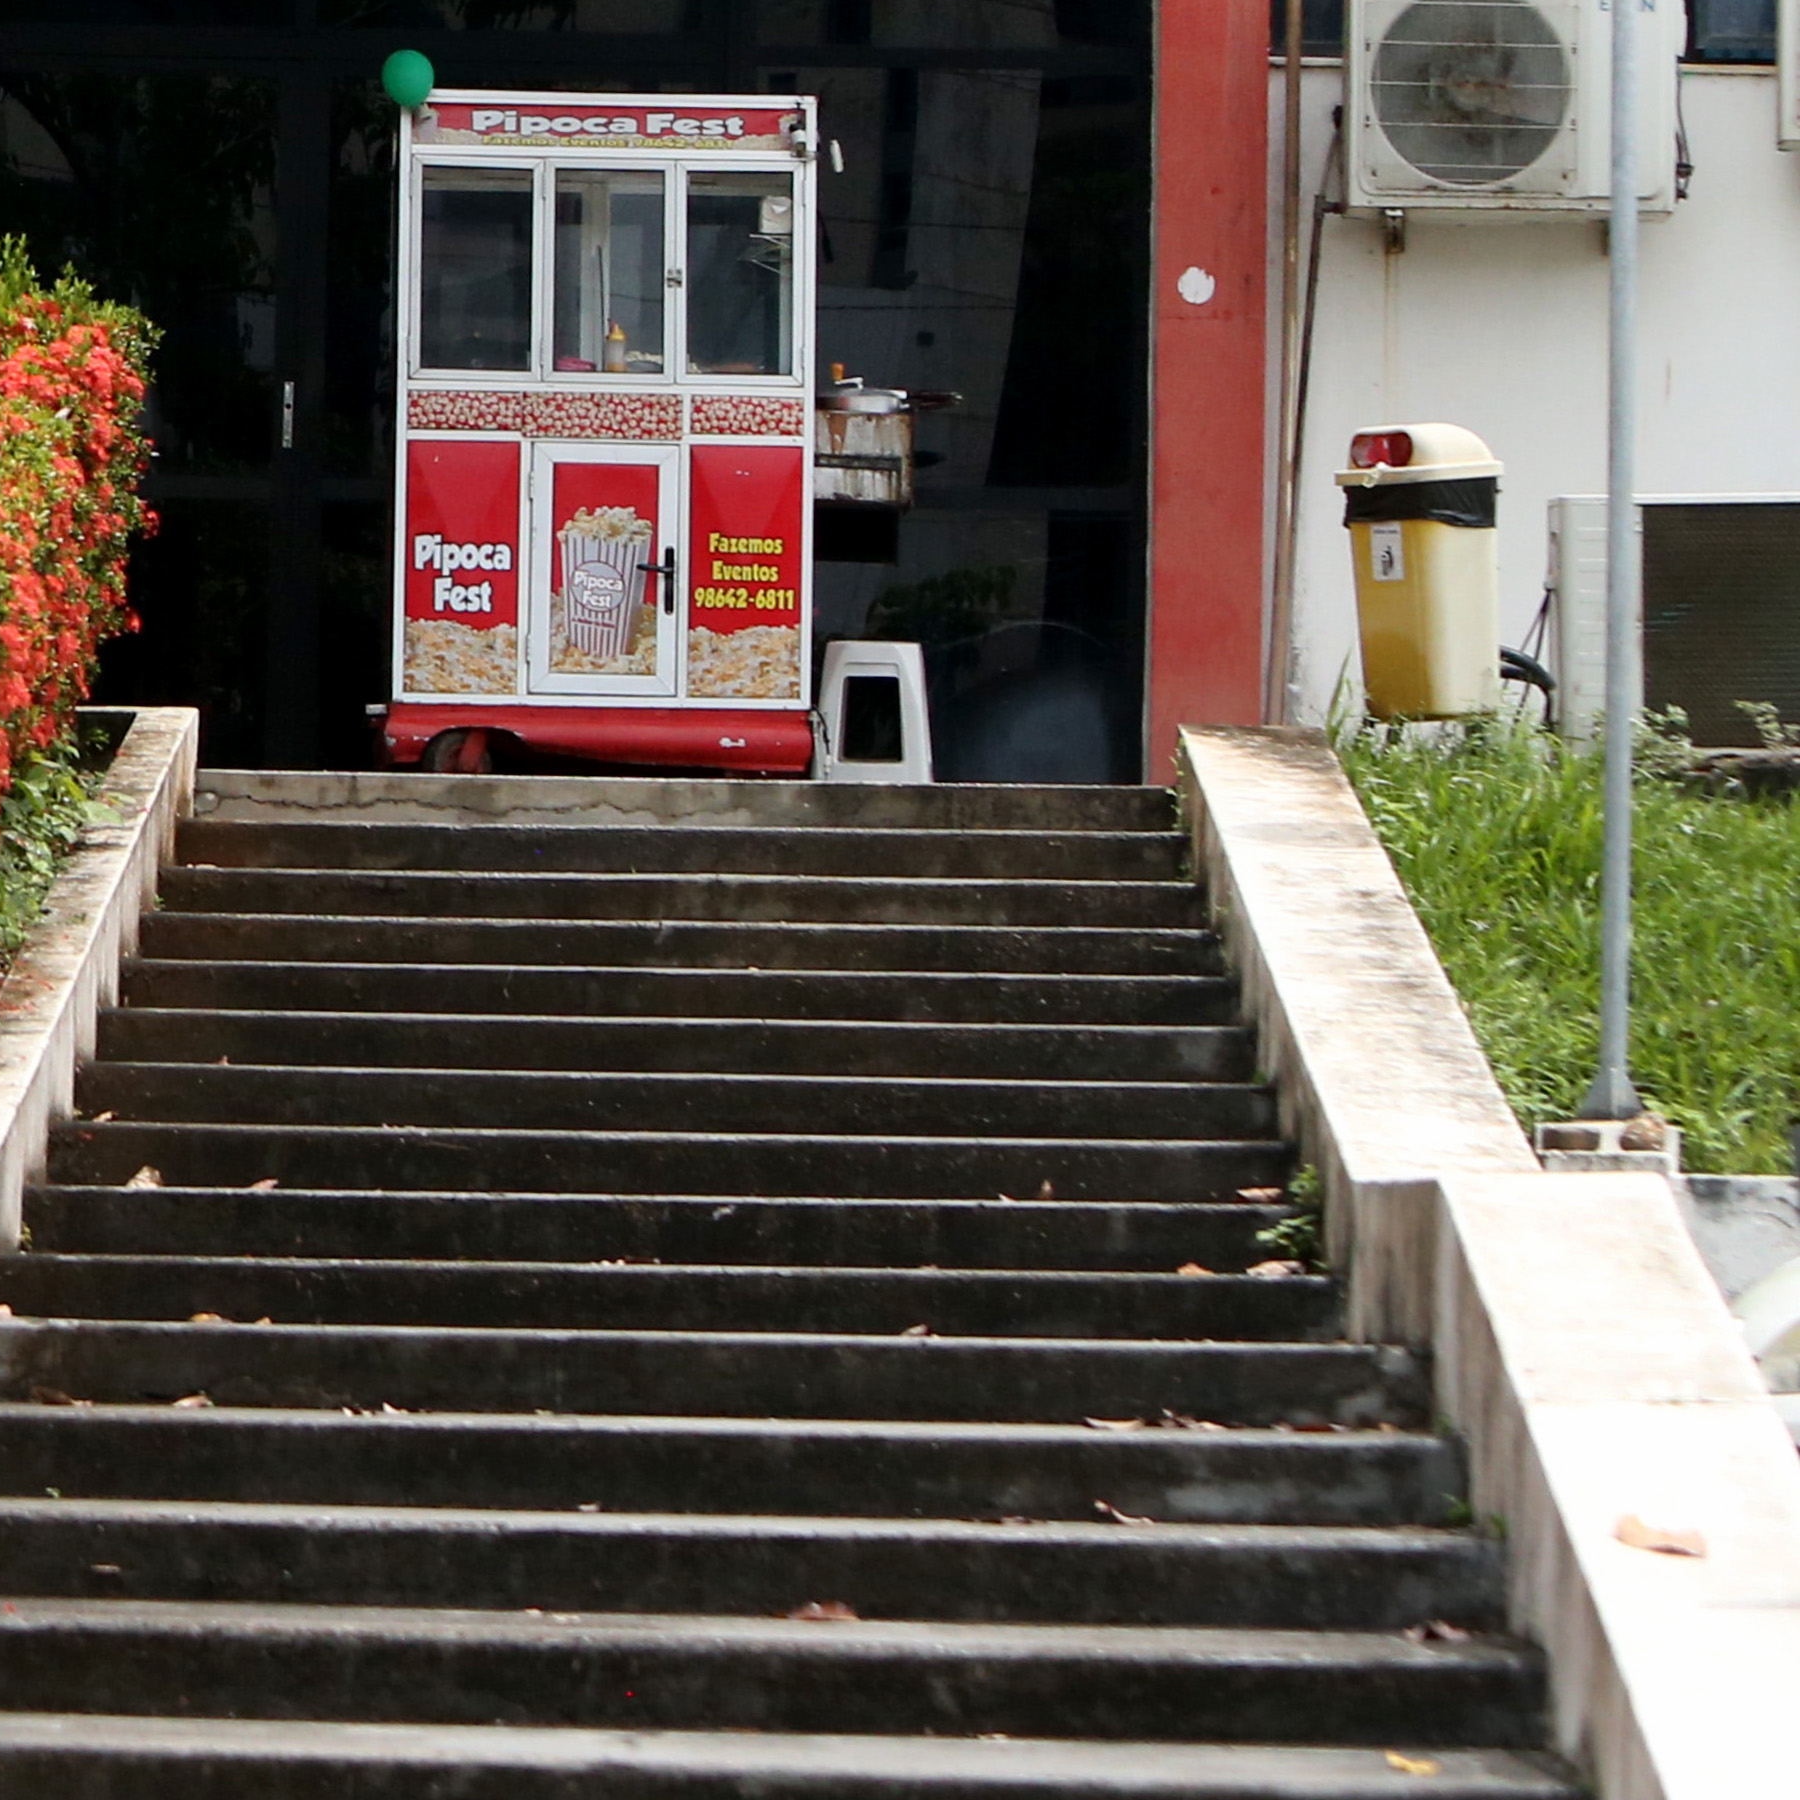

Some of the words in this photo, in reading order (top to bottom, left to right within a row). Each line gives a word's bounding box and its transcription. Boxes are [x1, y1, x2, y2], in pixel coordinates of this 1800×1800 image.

[470, 109, 638, 137] Pipoca
[645, 112, 745, 137] Fest
[413, 533, 512, 576] Pipoca
[708, 531, 784, 555] Fazemos
[572, 569, 625, 592] Pipoca
[712, 559, 780, 583] Eventos
[433, 576, 493, 613] Fest
[582, 589, 613, 609] Fest
[693, 585, 796, 611] 98642-6811
